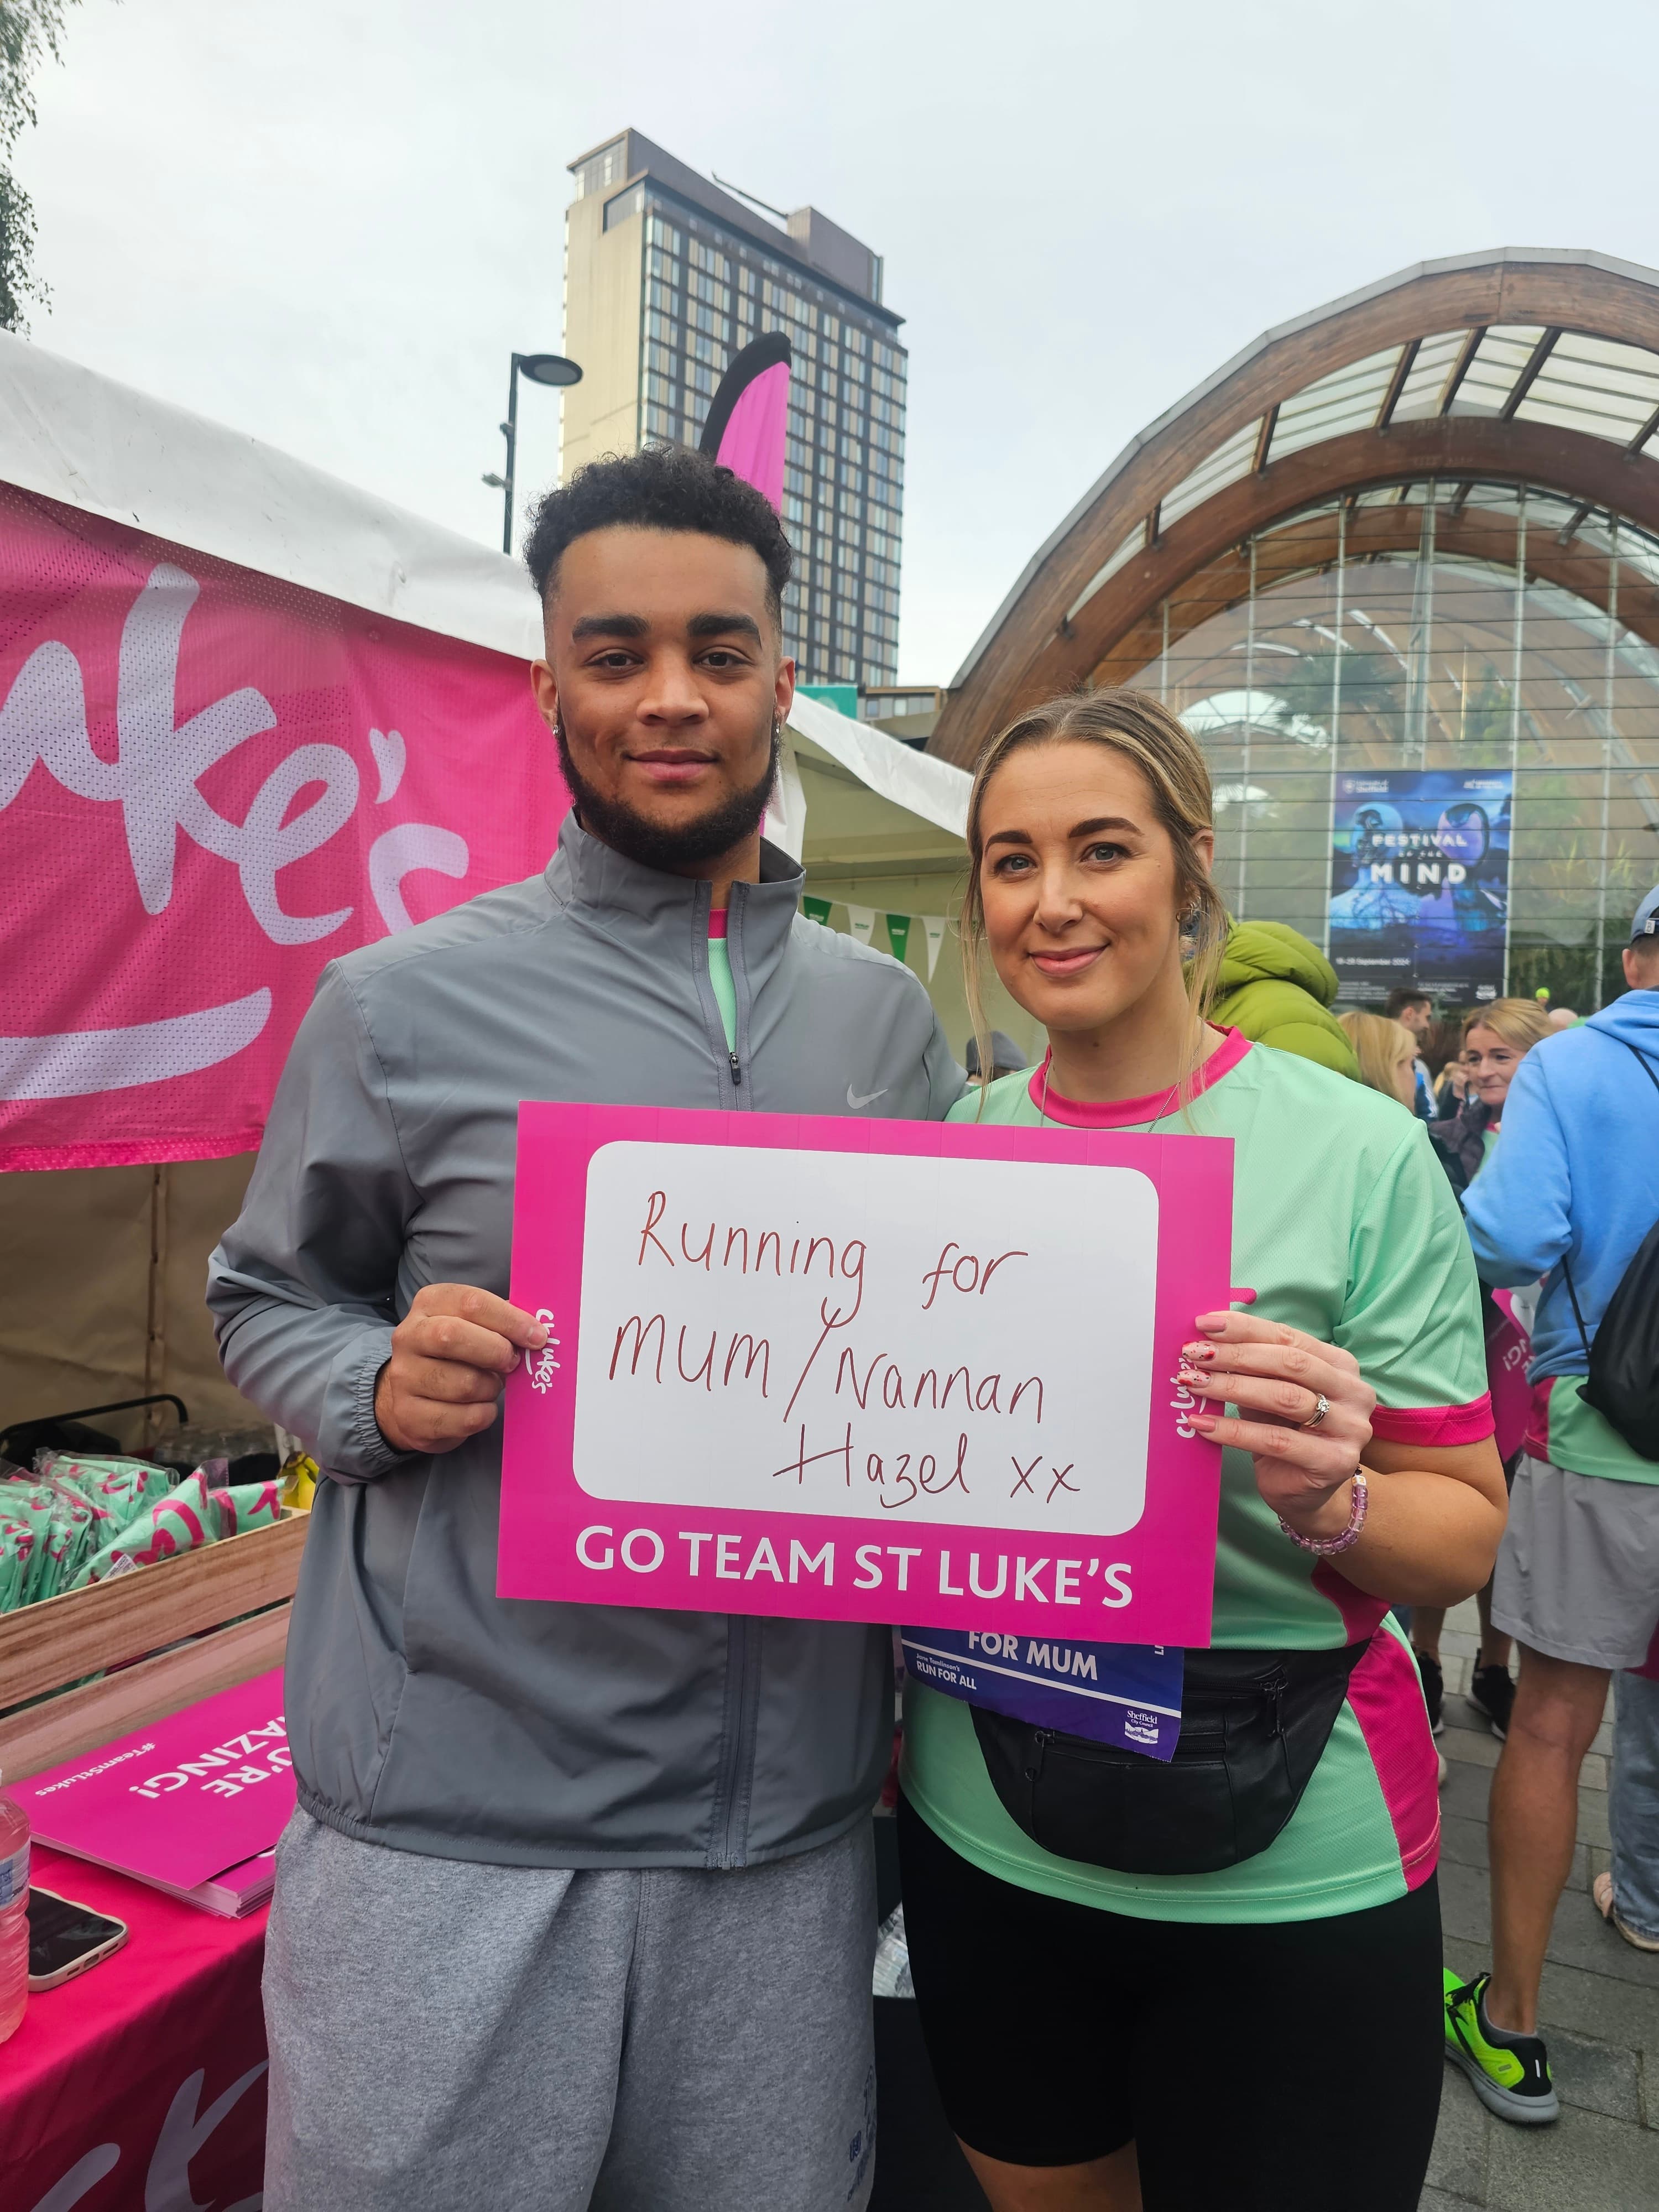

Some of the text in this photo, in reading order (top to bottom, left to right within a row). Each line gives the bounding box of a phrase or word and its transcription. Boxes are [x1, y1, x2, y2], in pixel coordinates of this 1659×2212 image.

[1372, 833, 1467, 847] FESTIVAL
[1371, 862, 1467, 884] MIND
[639, 1191, 1029, 1328] Running for
[773, 1422, 971, 1509] Hazel
[576, 1525, 1133, 1608] GO TEAM ST LUKE'S
[916, 1653, 960, 1672] Jane Tomlinson's
[916, 1661, 977, 1690] RUN FOR ALL
[968, 1631, 1098, 1681] FOR MUM
[1127, 1710, 1157, 1724] Sheffield
[35, 1743, 155, 1797] #TeamStLukes
[128, 1716, 287, 1799] AZING!
